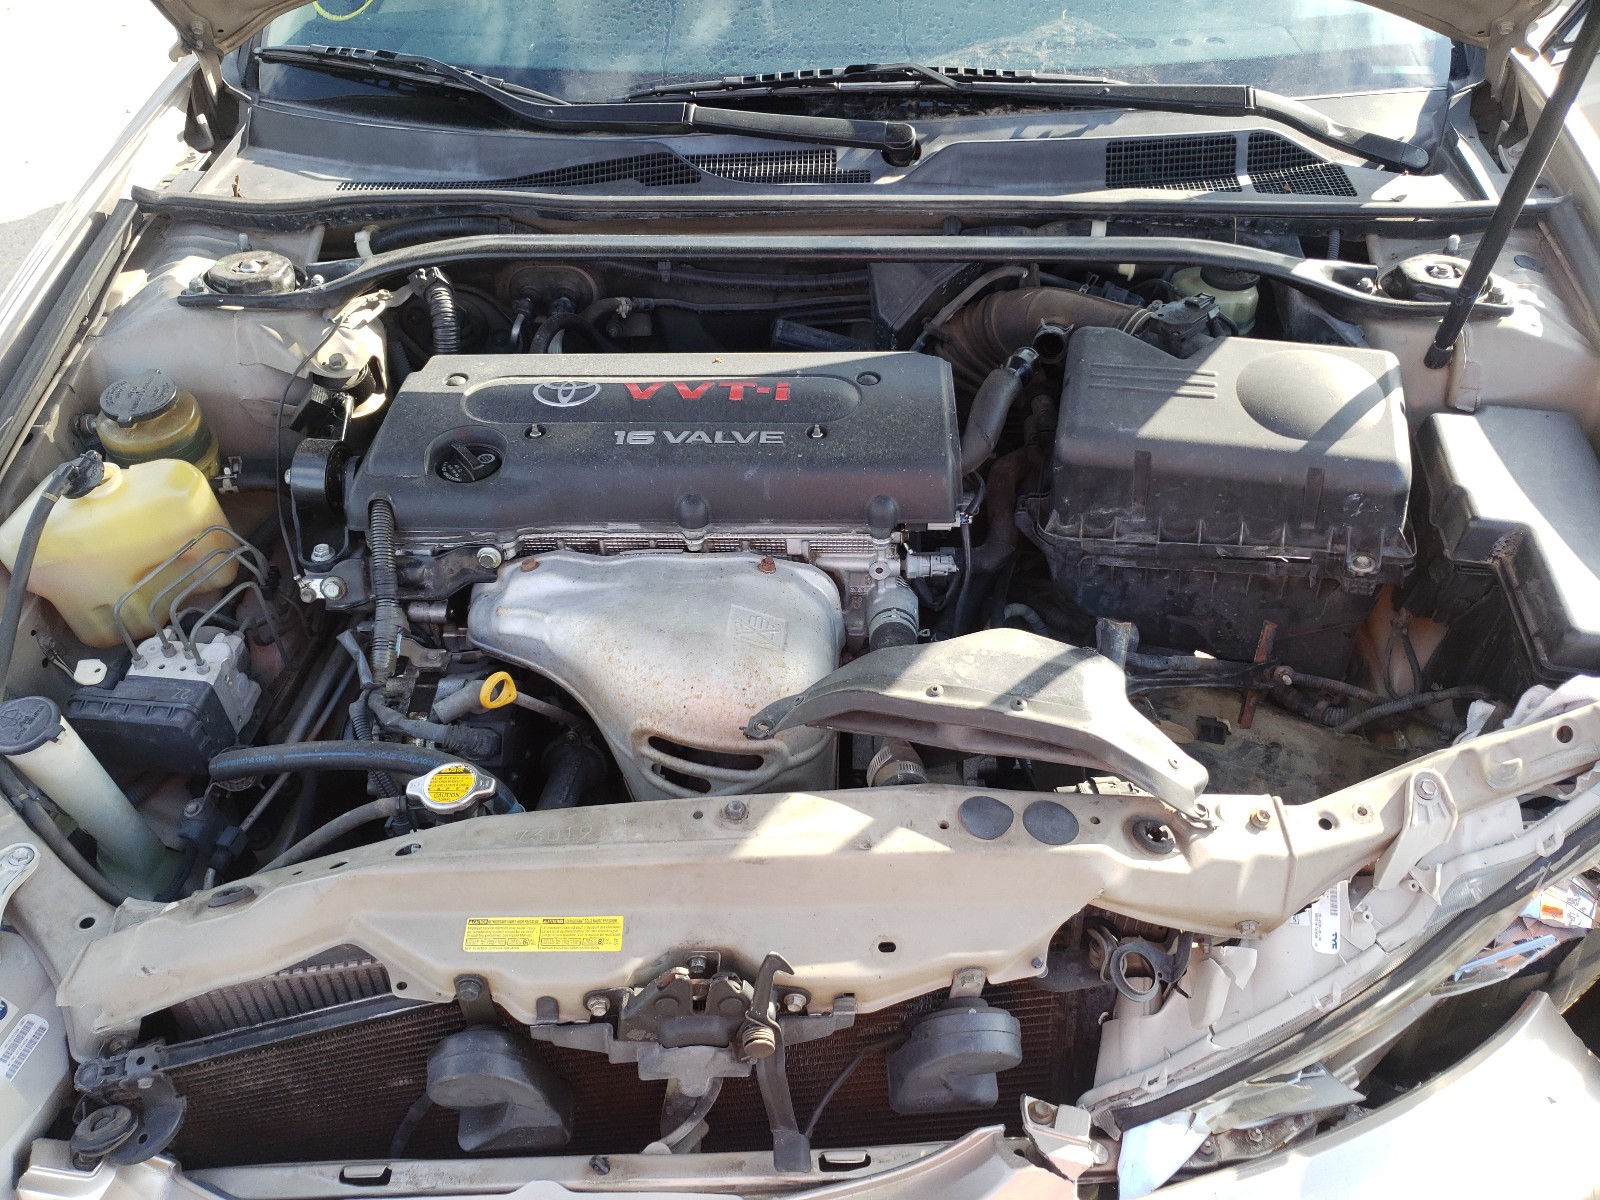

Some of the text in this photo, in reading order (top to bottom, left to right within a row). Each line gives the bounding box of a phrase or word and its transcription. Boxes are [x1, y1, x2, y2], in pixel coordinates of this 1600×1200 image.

[624, 381, 791, 401] VVT-i
[614, 430, 785, 445] 16 VALVE
